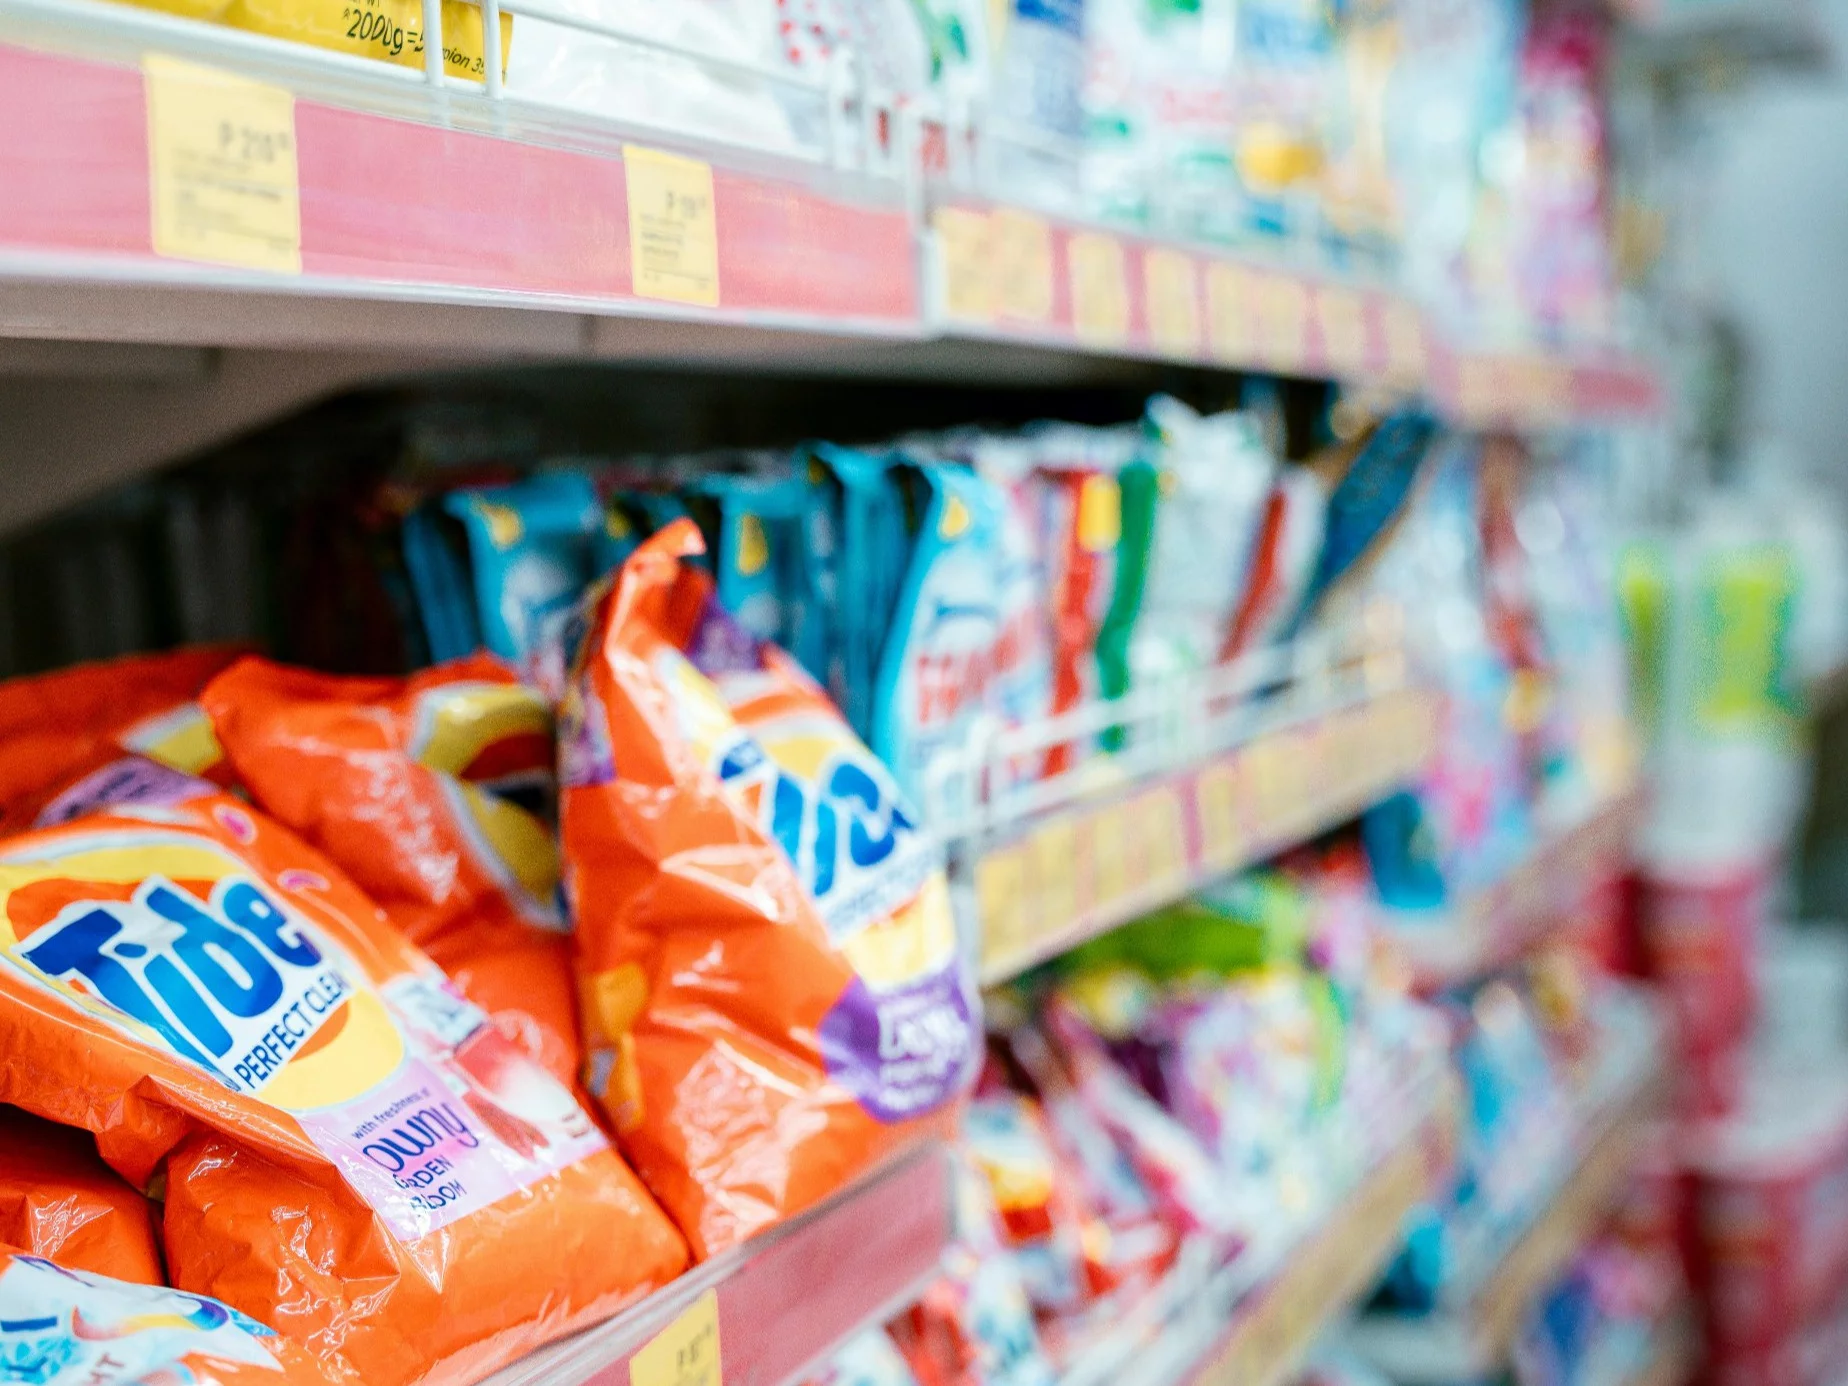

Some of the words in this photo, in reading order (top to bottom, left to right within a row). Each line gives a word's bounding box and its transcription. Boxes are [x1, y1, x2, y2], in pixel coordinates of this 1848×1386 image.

[21, 881, 322, 1081] Tide
[233, 1001, 313, 1090] PERFECT
[351, 1120, 379, 1140] with
